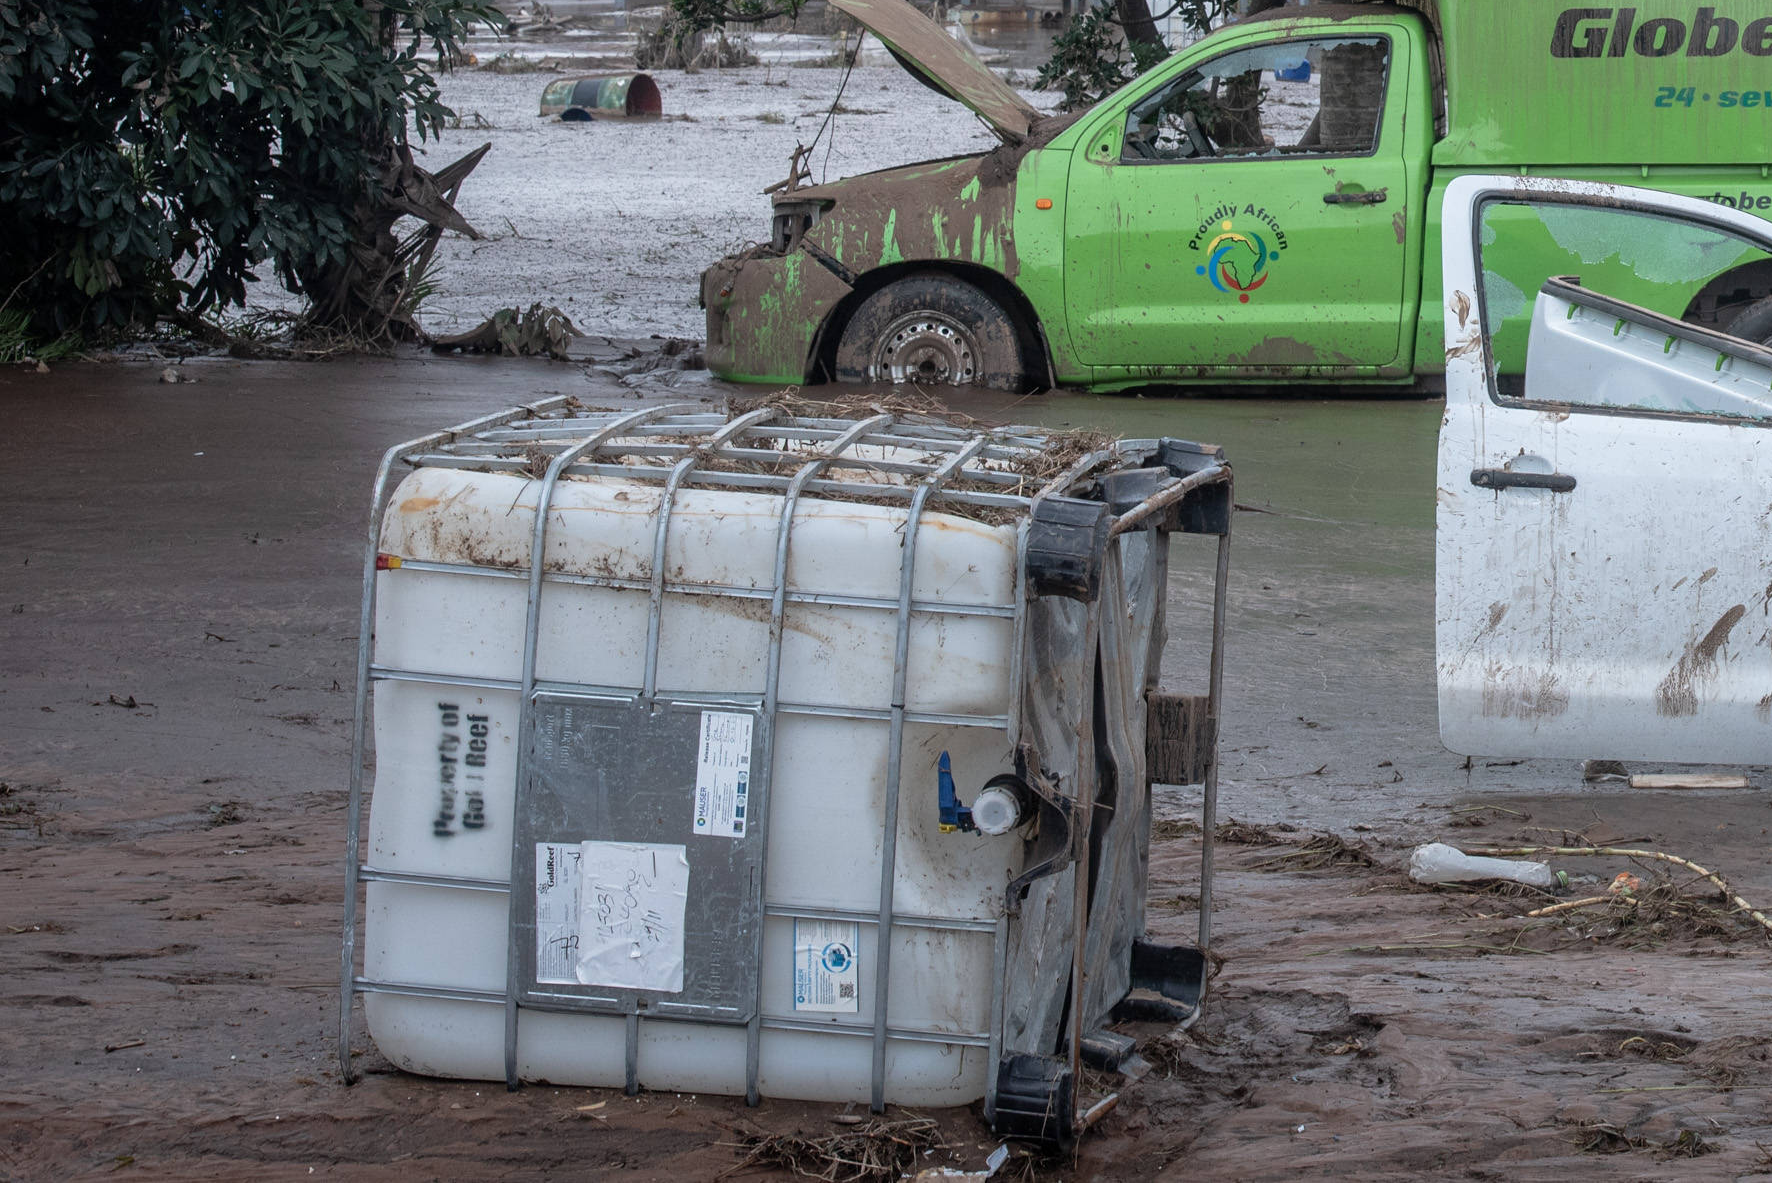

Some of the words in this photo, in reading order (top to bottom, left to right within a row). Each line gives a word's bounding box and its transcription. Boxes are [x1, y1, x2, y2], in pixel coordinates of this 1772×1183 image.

[1654, 86, 1695, 108] 24
[1188, 204, 1237, 251] Proudly
[1243, 203, 1288, 250] African
[438, 703, 459, 726] of
[464, 713, 489, 768] Reef
